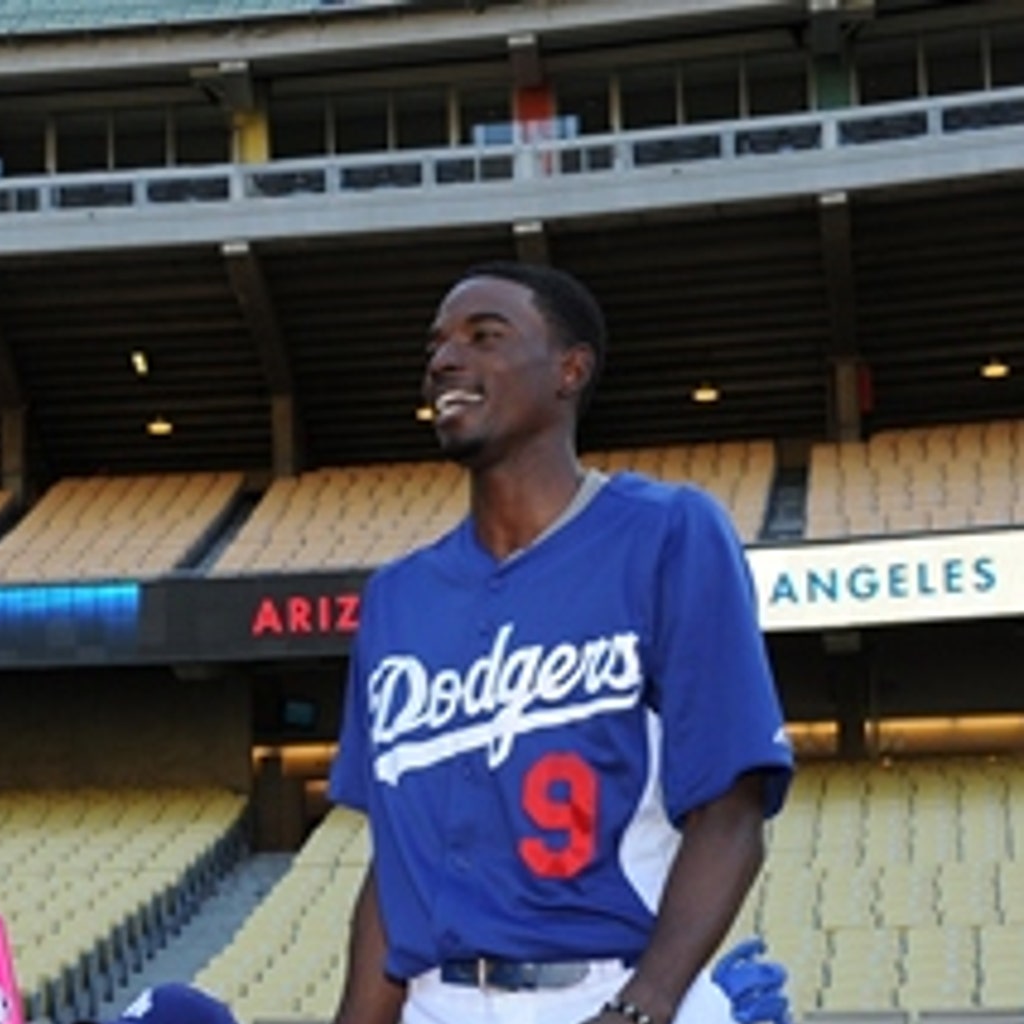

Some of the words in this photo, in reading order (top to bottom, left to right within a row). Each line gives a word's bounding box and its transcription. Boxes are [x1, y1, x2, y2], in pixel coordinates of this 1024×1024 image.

[770, 558, 997, 604] ANGELES
[368, 623, 641, 770] Dodgers
[519, 750, 598, 879] 9
